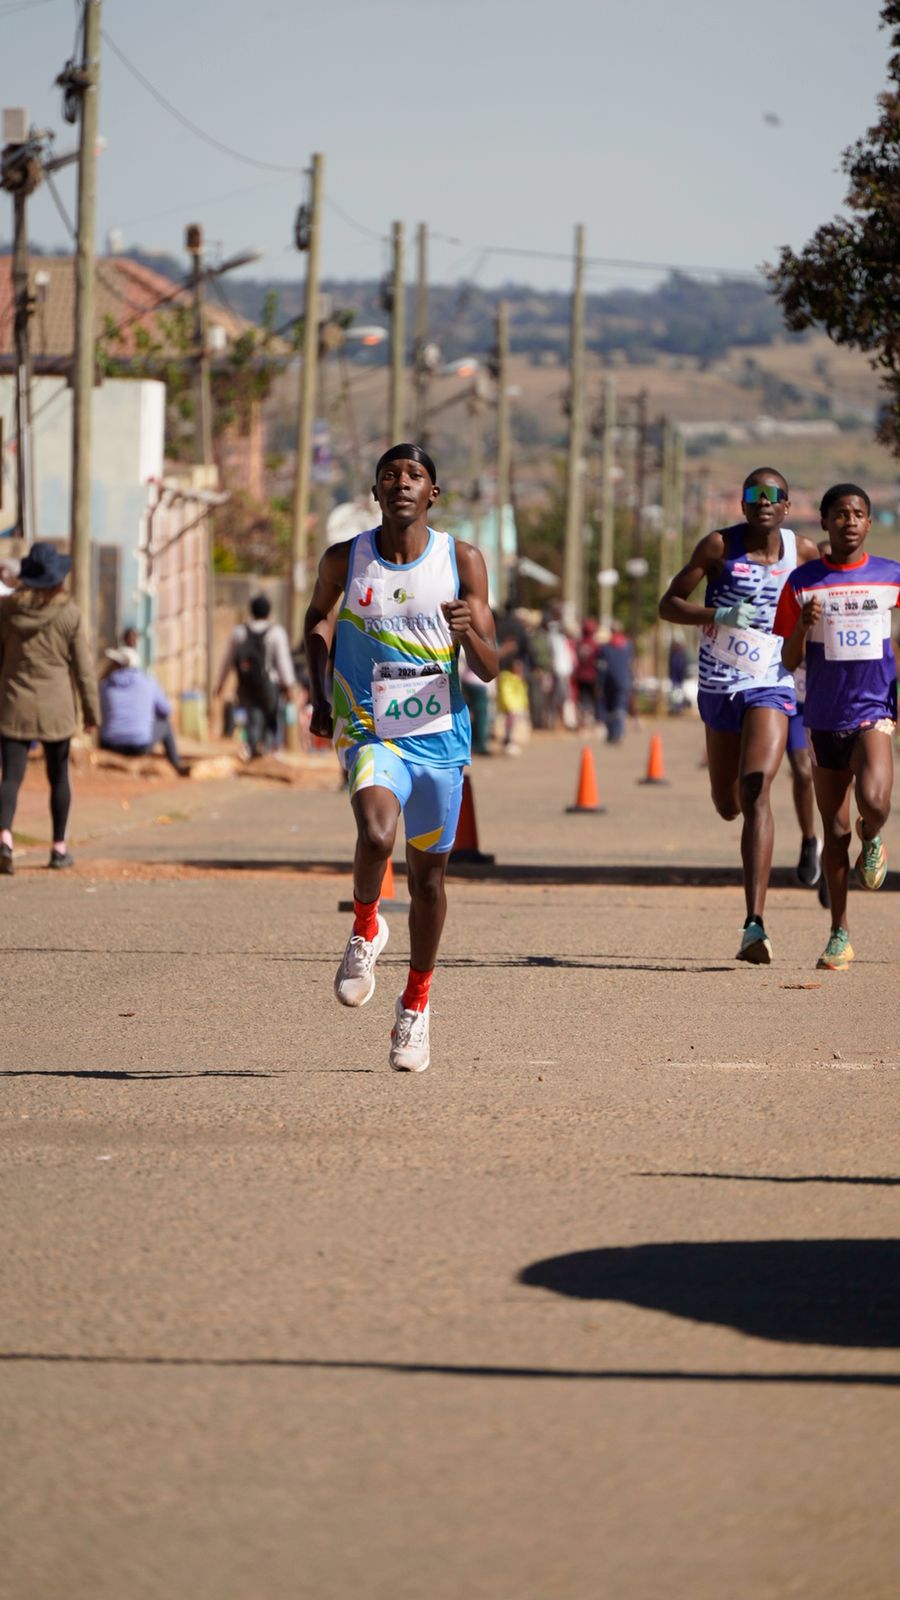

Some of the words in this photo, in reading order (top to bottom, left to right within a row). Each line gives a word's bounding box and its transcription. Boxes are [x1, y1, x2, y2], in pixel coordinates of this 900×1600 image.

[358, 587, 373, 607] J
[727, 635, 761, 662] 106
[836, 630, 871, 647] 182
[398, 668, 416, 677] 2026
[385, 694, 442, 720] 406
